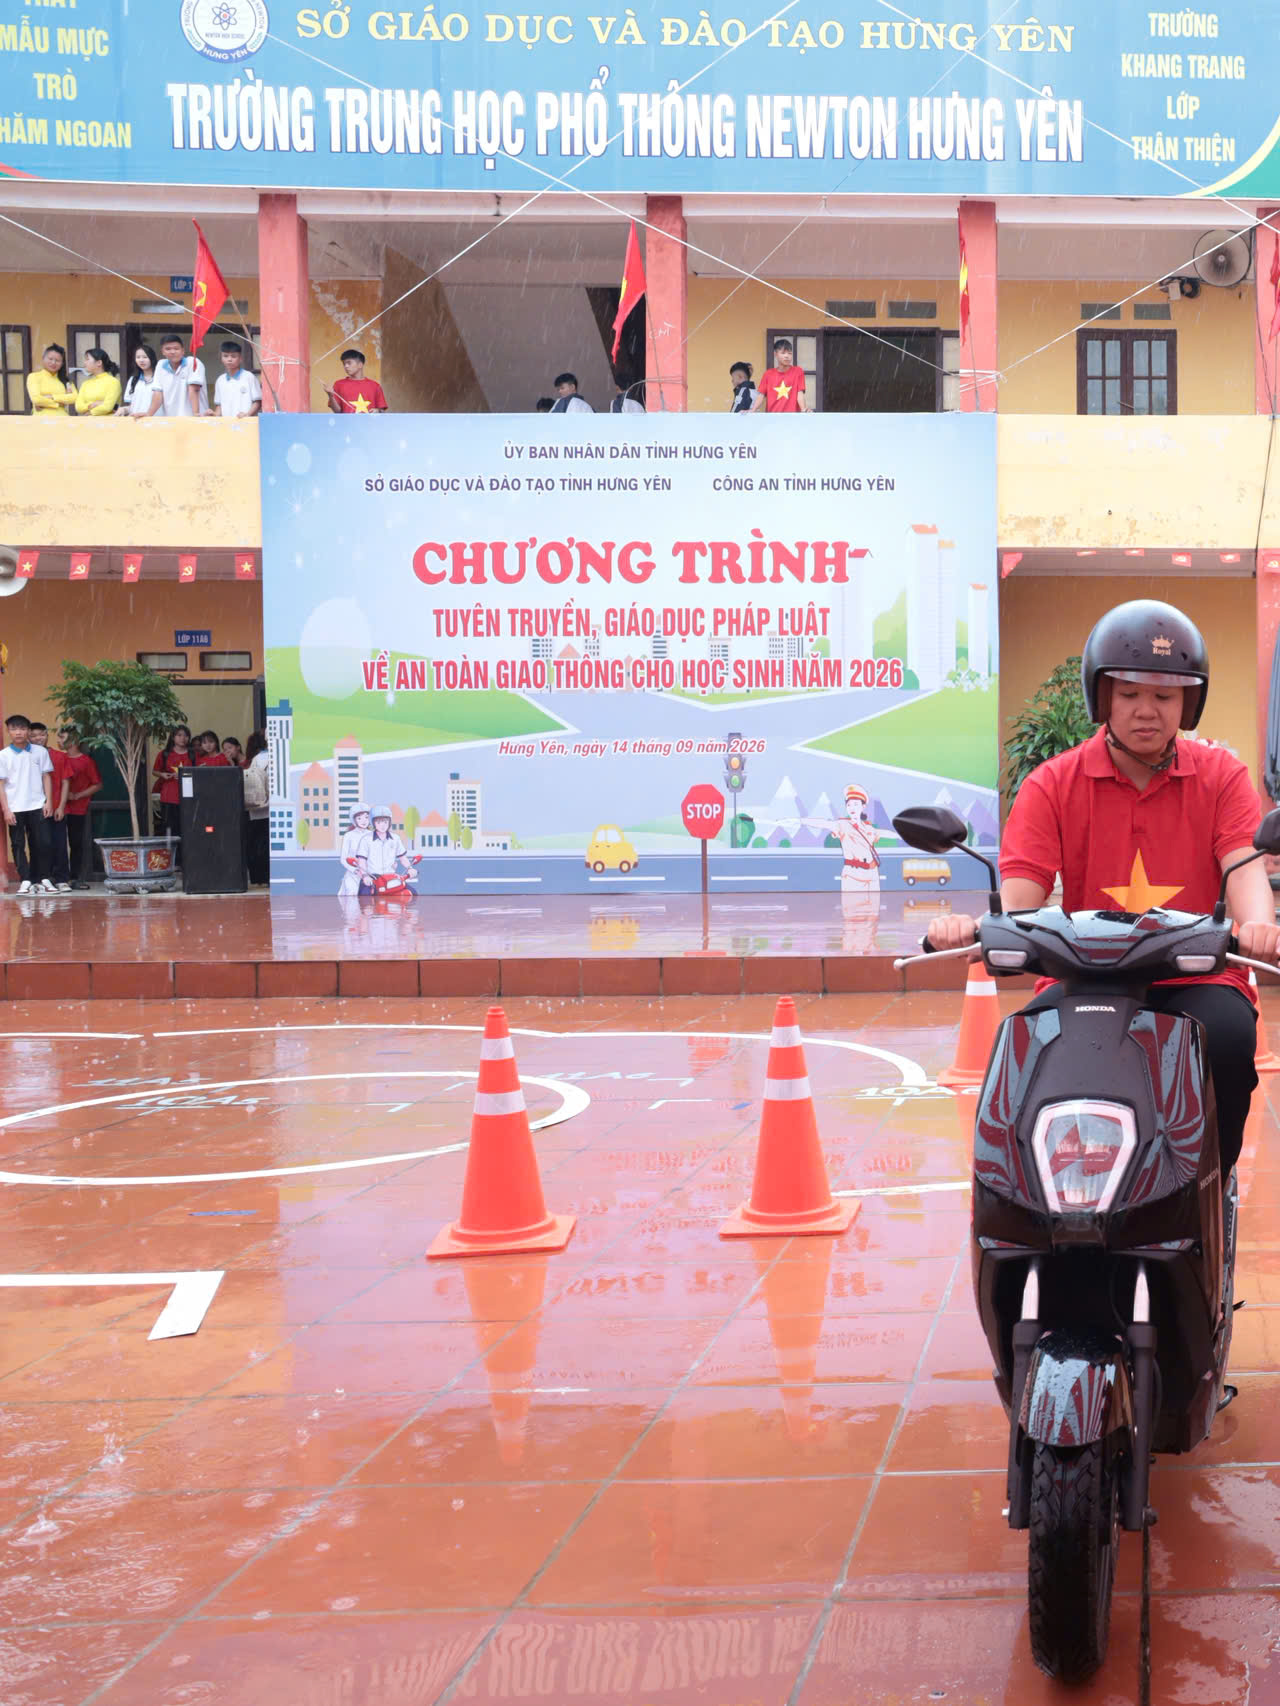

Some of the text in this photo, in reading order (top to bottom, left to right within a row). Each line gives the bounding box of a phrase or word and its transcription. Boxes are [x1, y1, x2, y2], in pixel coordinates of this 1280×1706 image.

[0, 15, 110, 62] MẪU MỰC
[296, 0, 1075, 55] SỞ GIÁO DỤC VÀ ĐÀO TẠO HƯNG YÊN
[1148, 8, 1220, 39] TRƯỜNG
[1121, 54, 1246, 80] KHANG TRANG
[33, 67, 78, 101] TRÒ
[166, 65, 1085, 171] TRƯỜNG TRUNG HỌC PHỔ THÔNG NEWTON HƯNG YÊN
[1166, 90, 1201, 120] LỚP
[55, 119, 132, 149] NGOAN
[1130, 131, 1236, 167] THÂN THIỆN
[504, 440, 757, 460] ỦY BAN NHÂN DÂN TỈNH HƯNG YÊN
[365, 473, 672, 496] SỞ GIÁO DỤC VÀ ĐÀO TẠO TỈNH HƯNG YÊN
[713, 473, 895, 492] CÔNG AN TỈNH HƯNG YÊN
[412, 527, 850, 585] CHƯƠNG TRÌNH
[432, 598, 830, 643] TUYÊN TRUYỀN, GIÁO DỤC PHÁP LUẬT
[1152, 647, 1171, 656] Royal
[362, 651, 902, 695] VỀ AN TOÀN GIAO THÔNG CHO HỌC SINH NĂM 2026
[499, 739, 766, 757] Hưng Yên, ngày 14 tháng 09 năm 2026
[687, 803, 721, 819] STOP
[1075, 1005, 1117, 1013] HONDA
